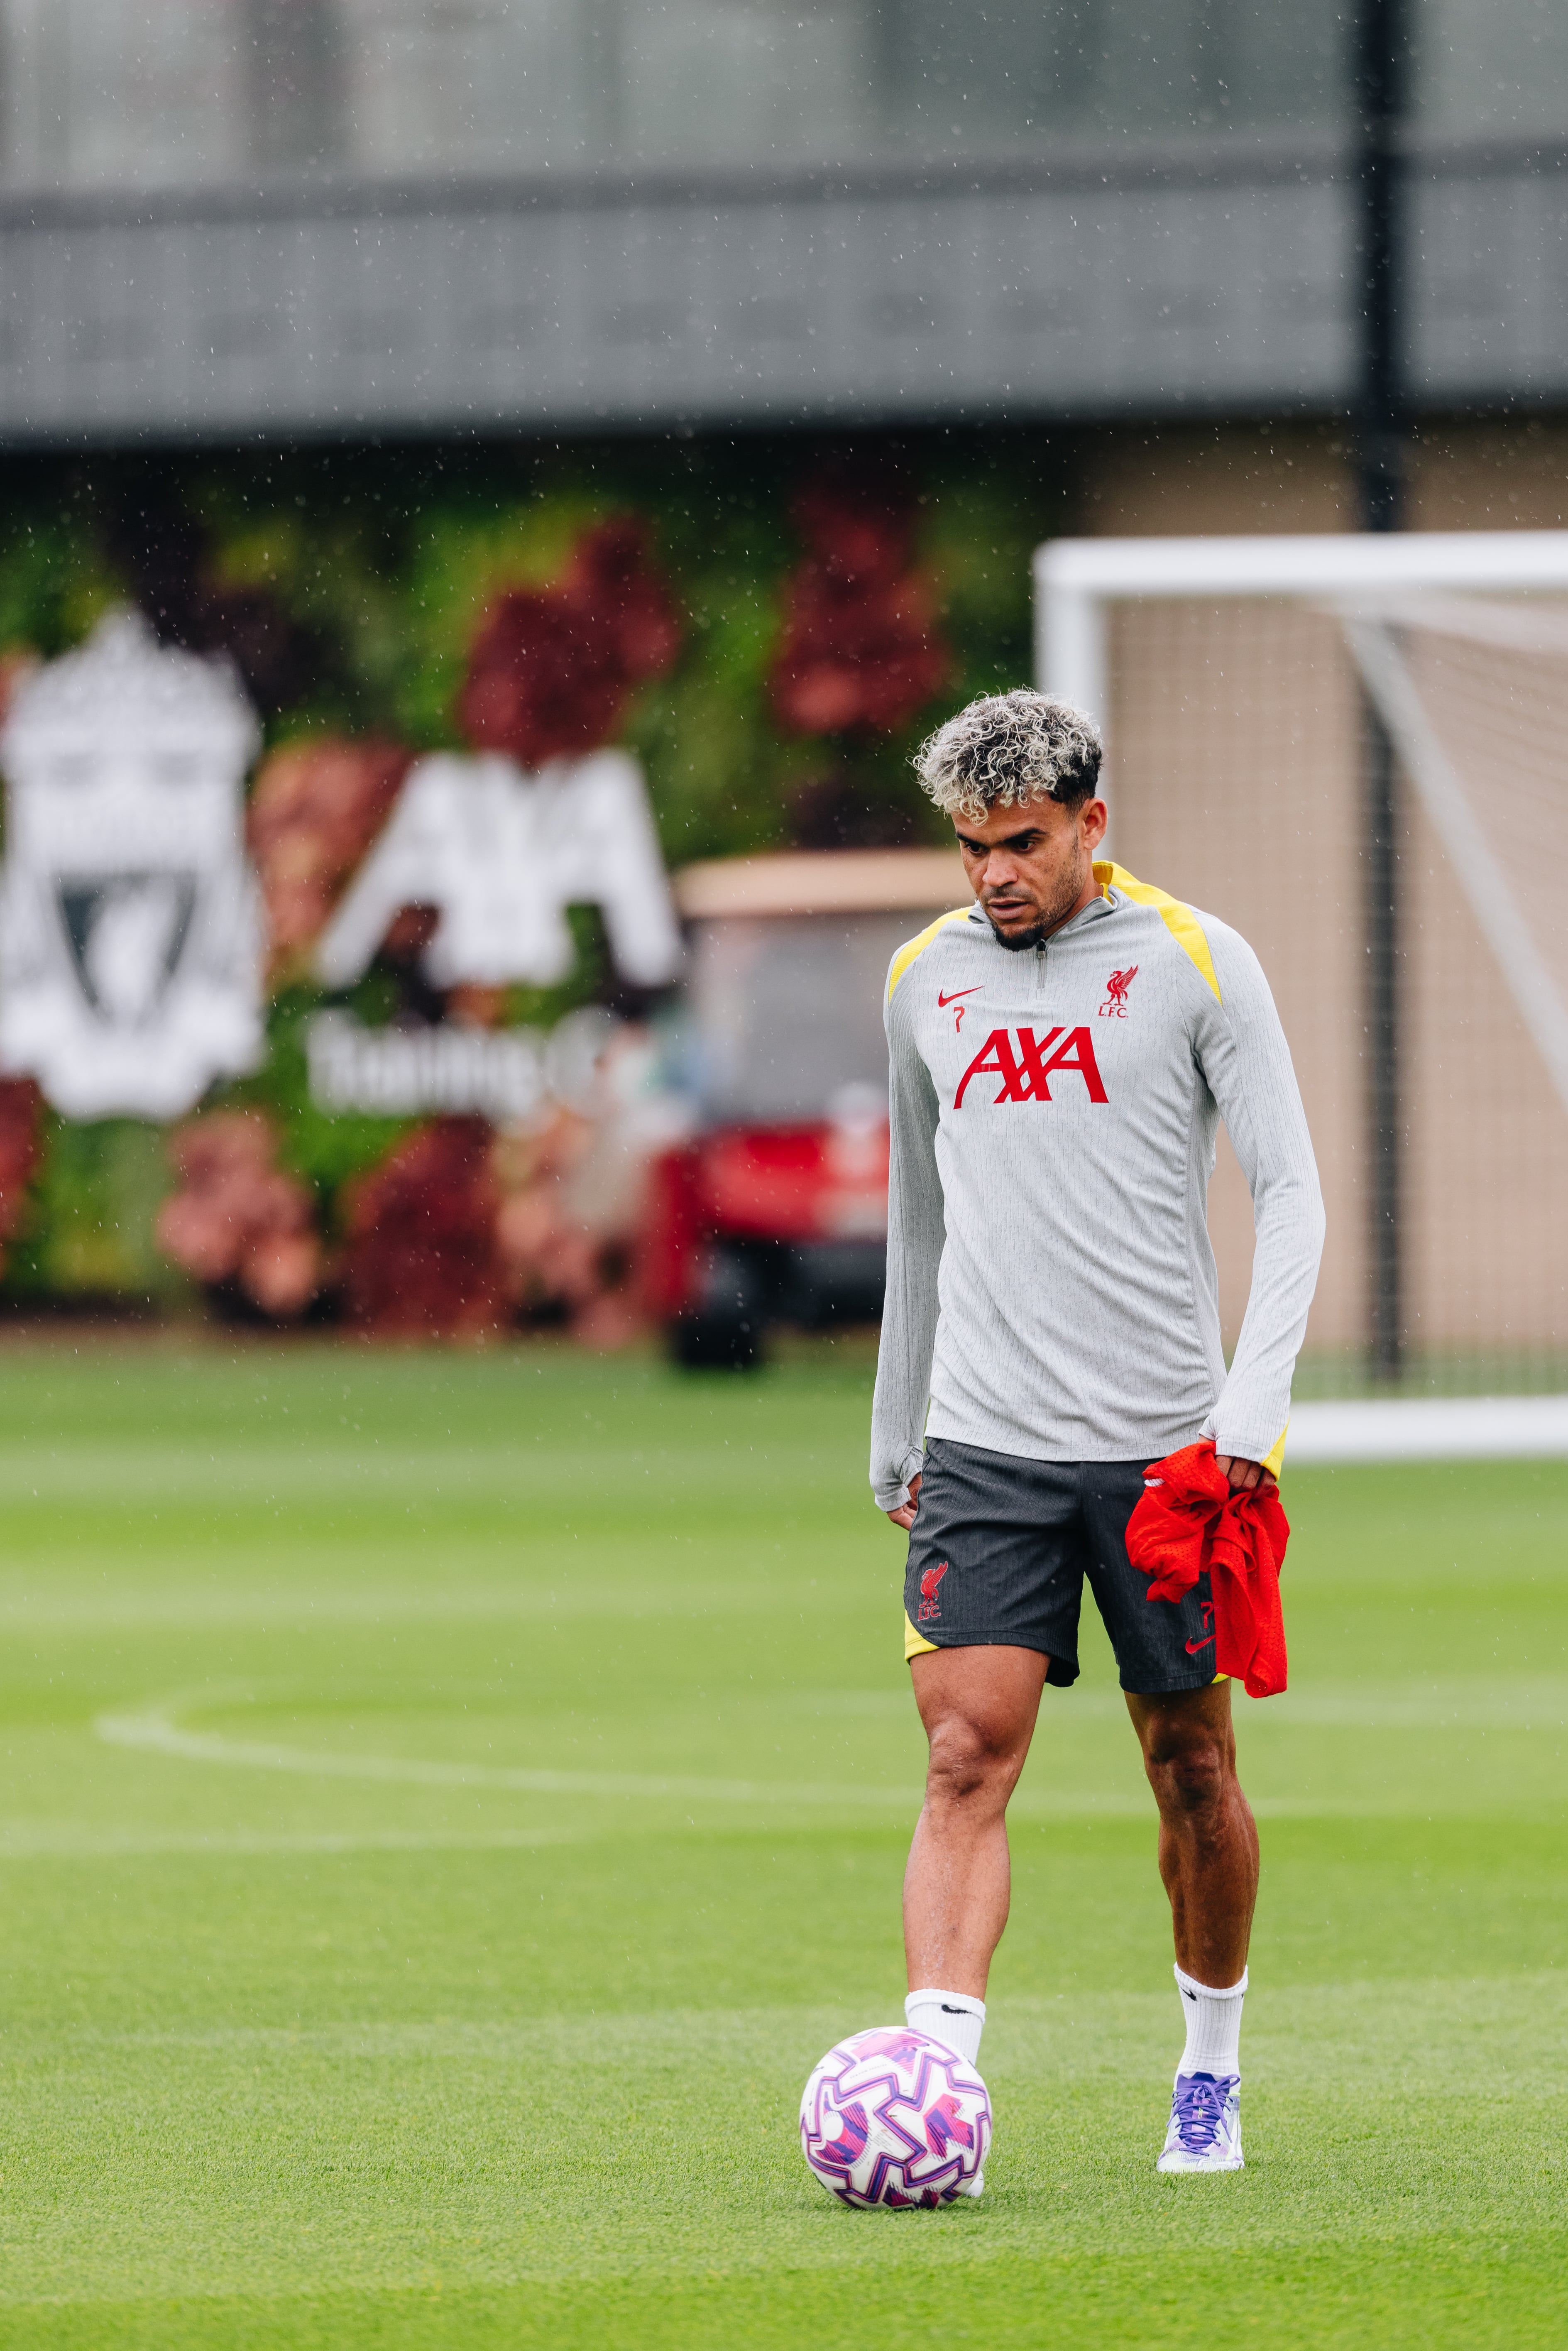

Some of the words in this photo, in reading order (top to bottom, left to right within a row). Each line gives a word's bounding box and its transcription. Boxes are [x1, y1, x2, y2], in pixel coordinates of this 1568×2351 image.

[954, 1006, 965, 1033] 7
[953, 1027, 1109, 1109] AXA
[1201, 1601, 1213, 1629] 7
